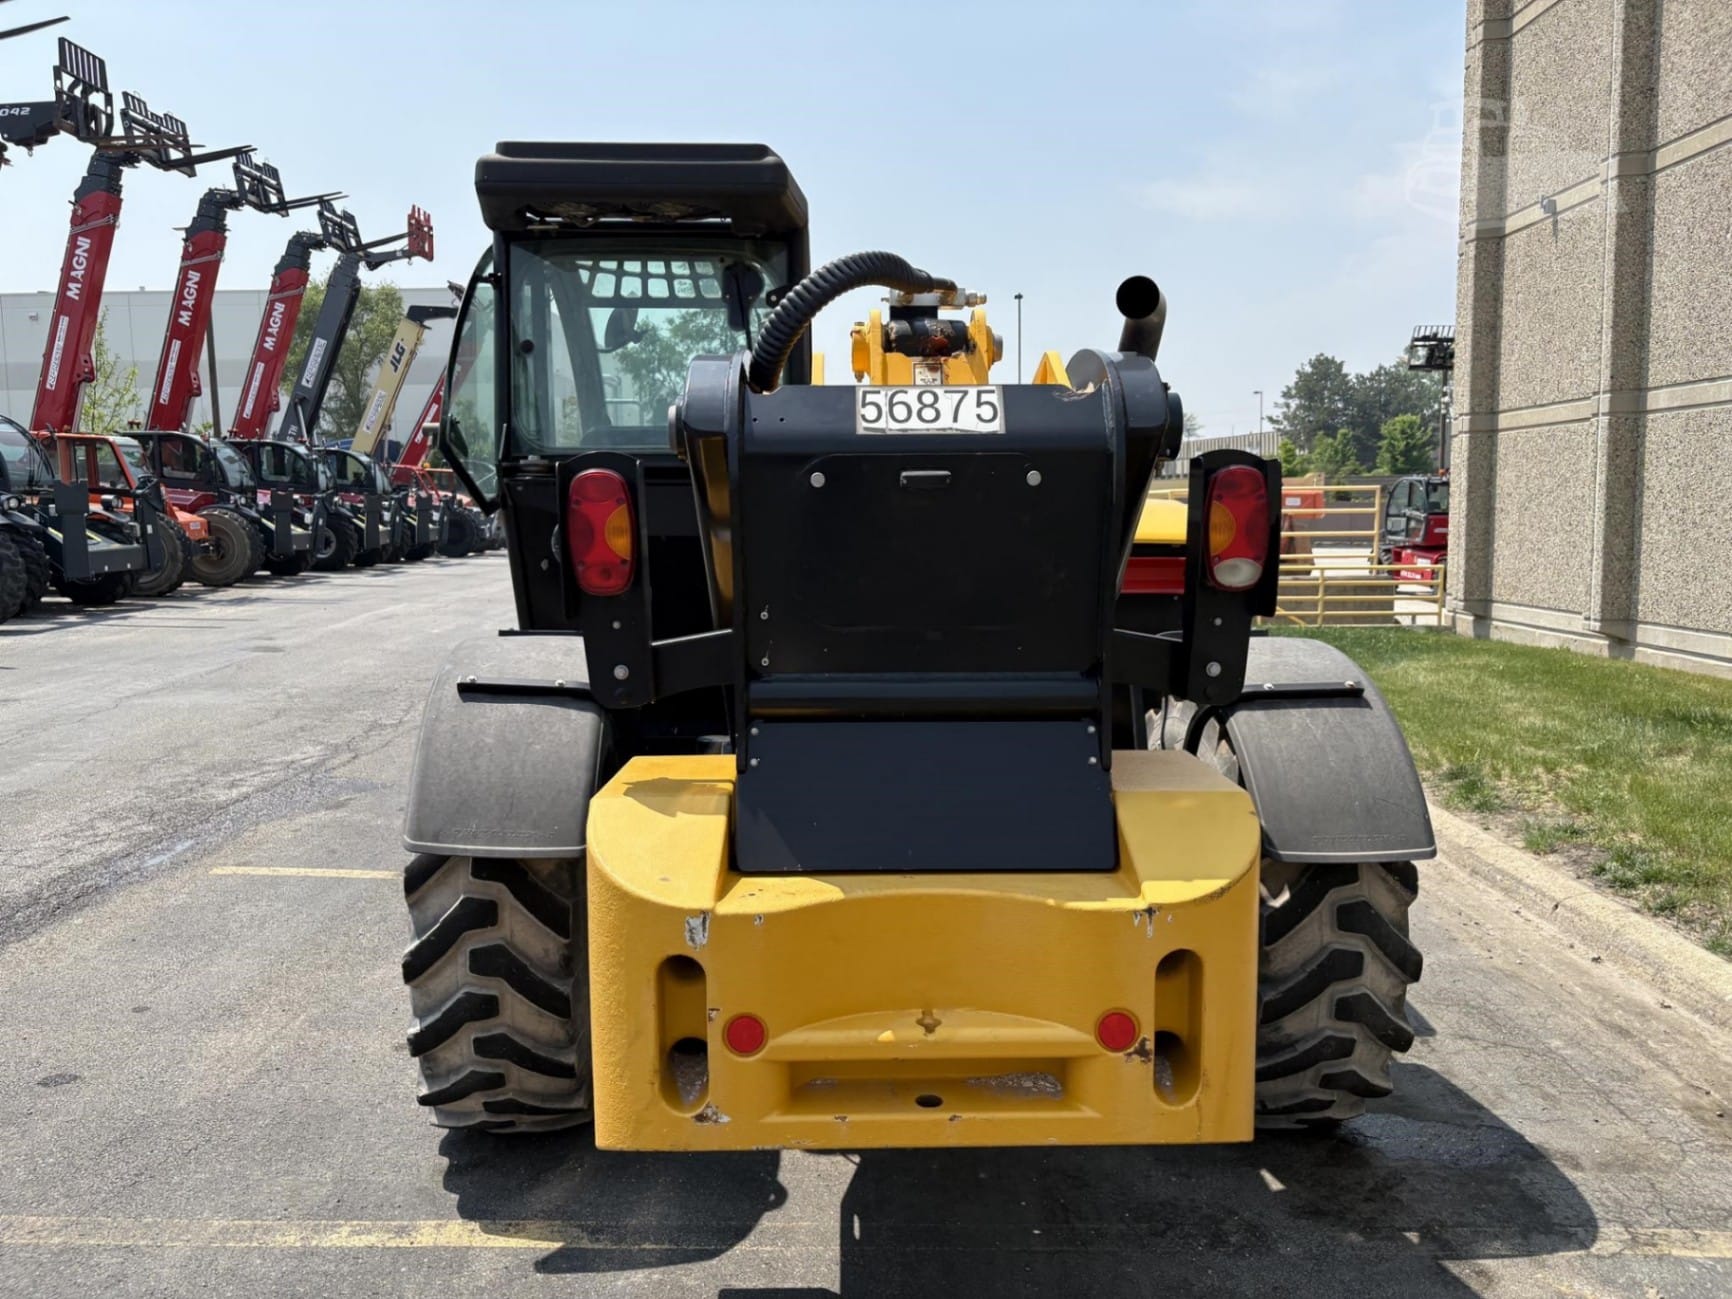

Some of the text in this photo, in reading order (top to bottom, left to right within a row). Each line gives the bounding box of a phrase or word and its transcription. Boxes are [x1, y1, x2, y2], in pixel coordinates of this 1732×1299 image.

[66, 236, 92, 300] MAGNI
[178, 270, 201, 327] MAGNI
[263, 302, 286, 351] MAGNI
[390, 341, 406, 373] JLG
[860, 389, 999, 424] 56875
